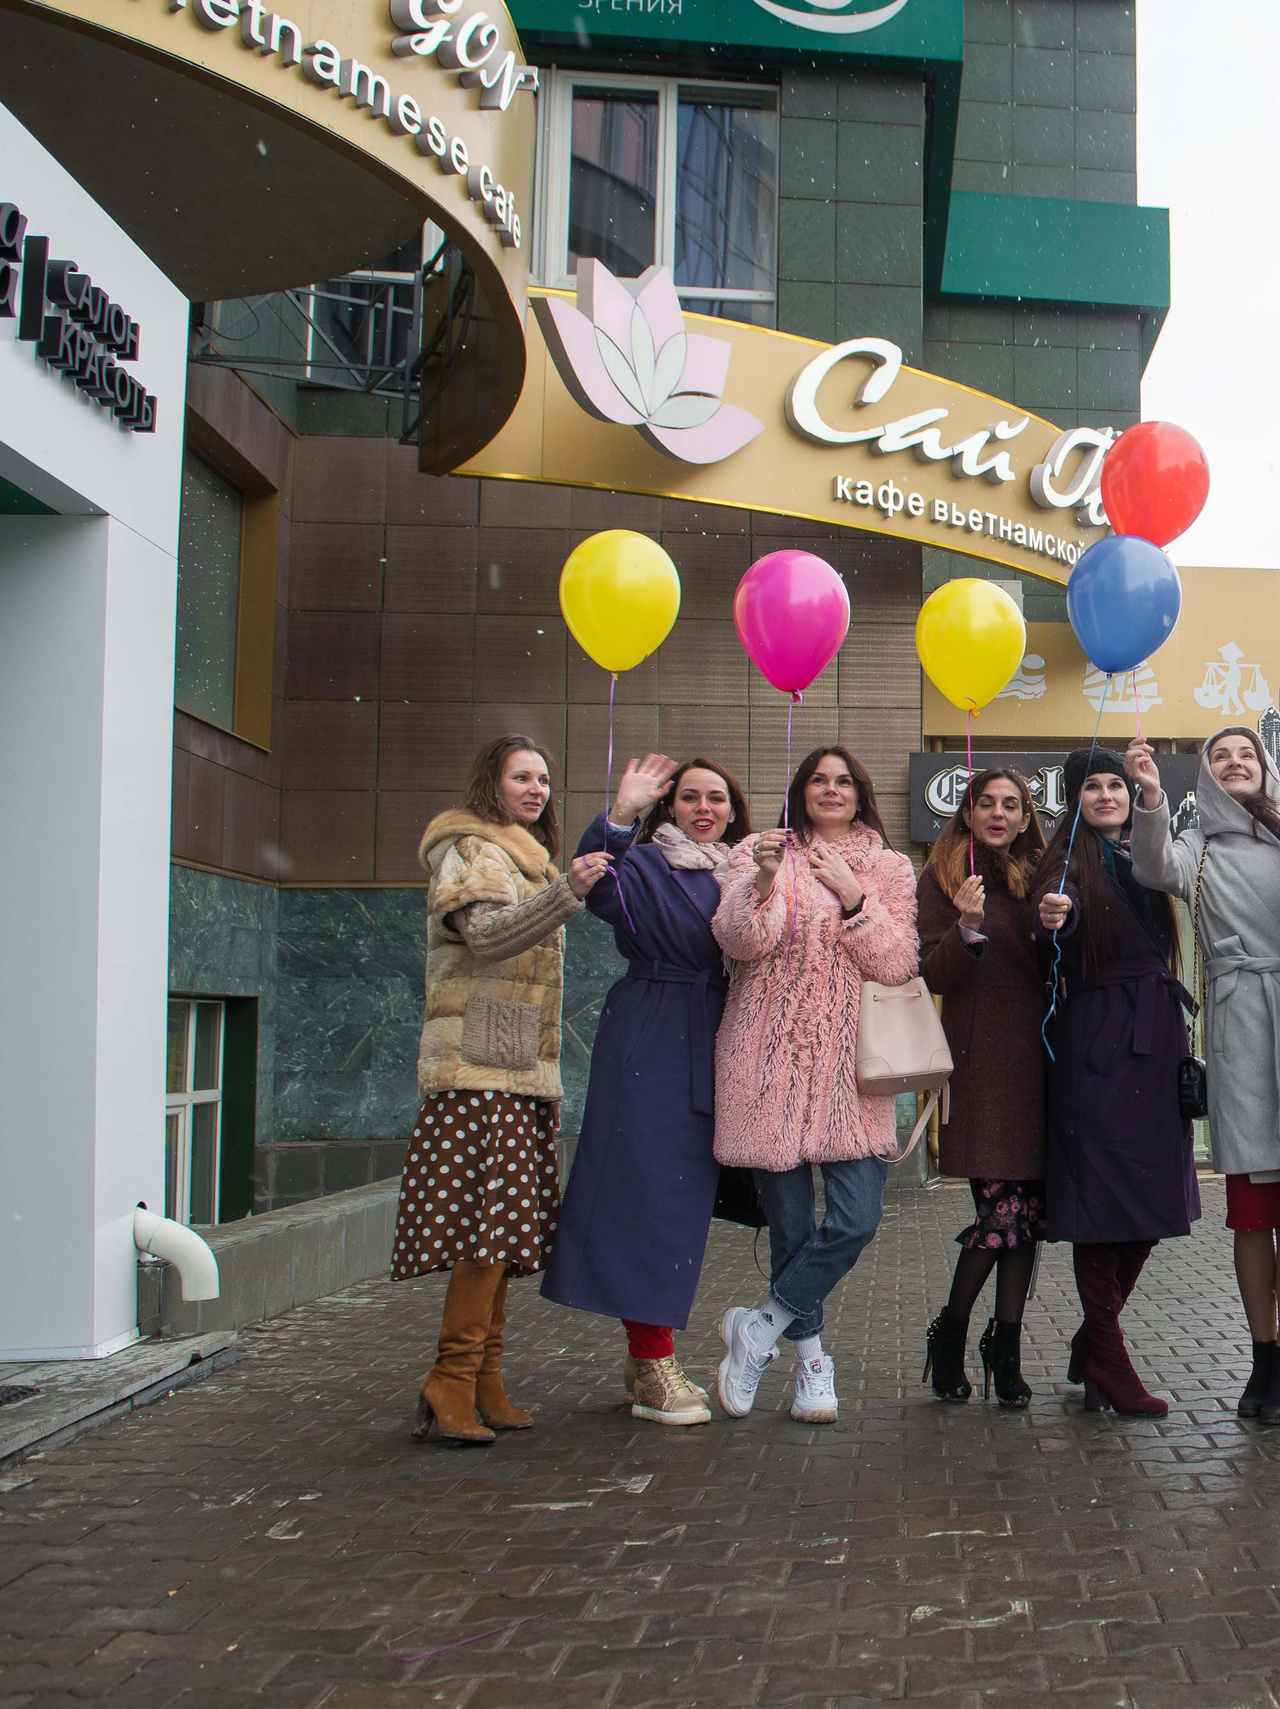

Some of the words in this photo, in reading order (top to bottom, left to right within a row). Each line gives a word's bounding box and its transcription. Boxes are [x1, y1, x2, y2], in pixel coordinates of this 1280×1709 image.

[172, 0, 470, 176] etnamese
[472, 164, 522, 249] cafe
[48, 259, 140, 361] САЛОН
[40, 316, 158, 433] КРАСОТЫ
[787, 337, 1030, 482] Сай
[835, 475, 926, 519] кафе
